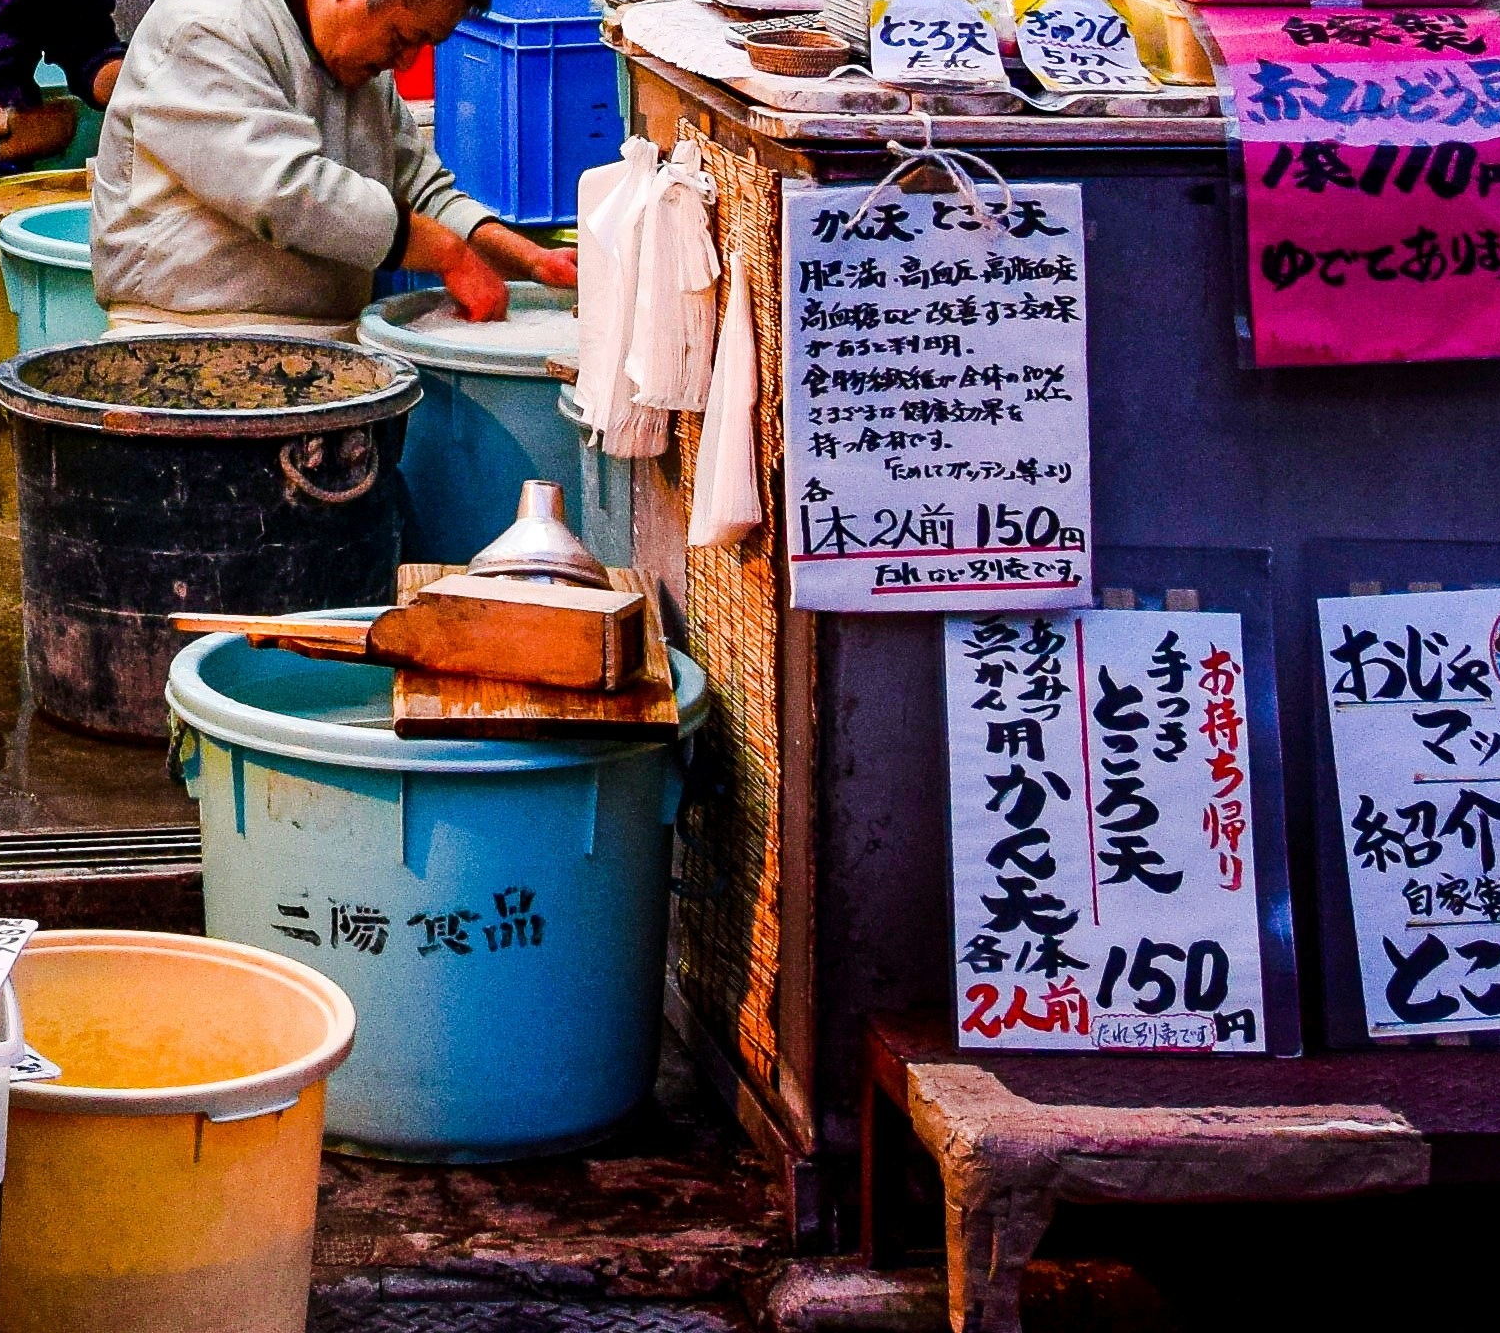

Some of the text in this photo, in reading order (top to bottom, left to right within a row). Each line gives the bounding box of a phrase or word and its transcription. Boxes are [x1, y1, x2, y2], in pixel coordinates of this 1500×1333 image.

[880, 15, 995, 55] ところ天
[1022, 10, 1130, 47] ぎゅうひ
[1281, 15, 1487, 55] 自家製
[977, 502, 1086, 551] 150円
[964, 619, 1019, 713] 豆かん
[1019, 621, 1072, 721] あんみつ
[1147, 630, 1194, 763] 手つき
[1331, 622, 1492, 703] おじゃ
[1094, 664, 1184, 894] ところ天
[1199, 642, 1246, 892] お持ち帰り
[1095, 938, 1256, 1044] 150円
